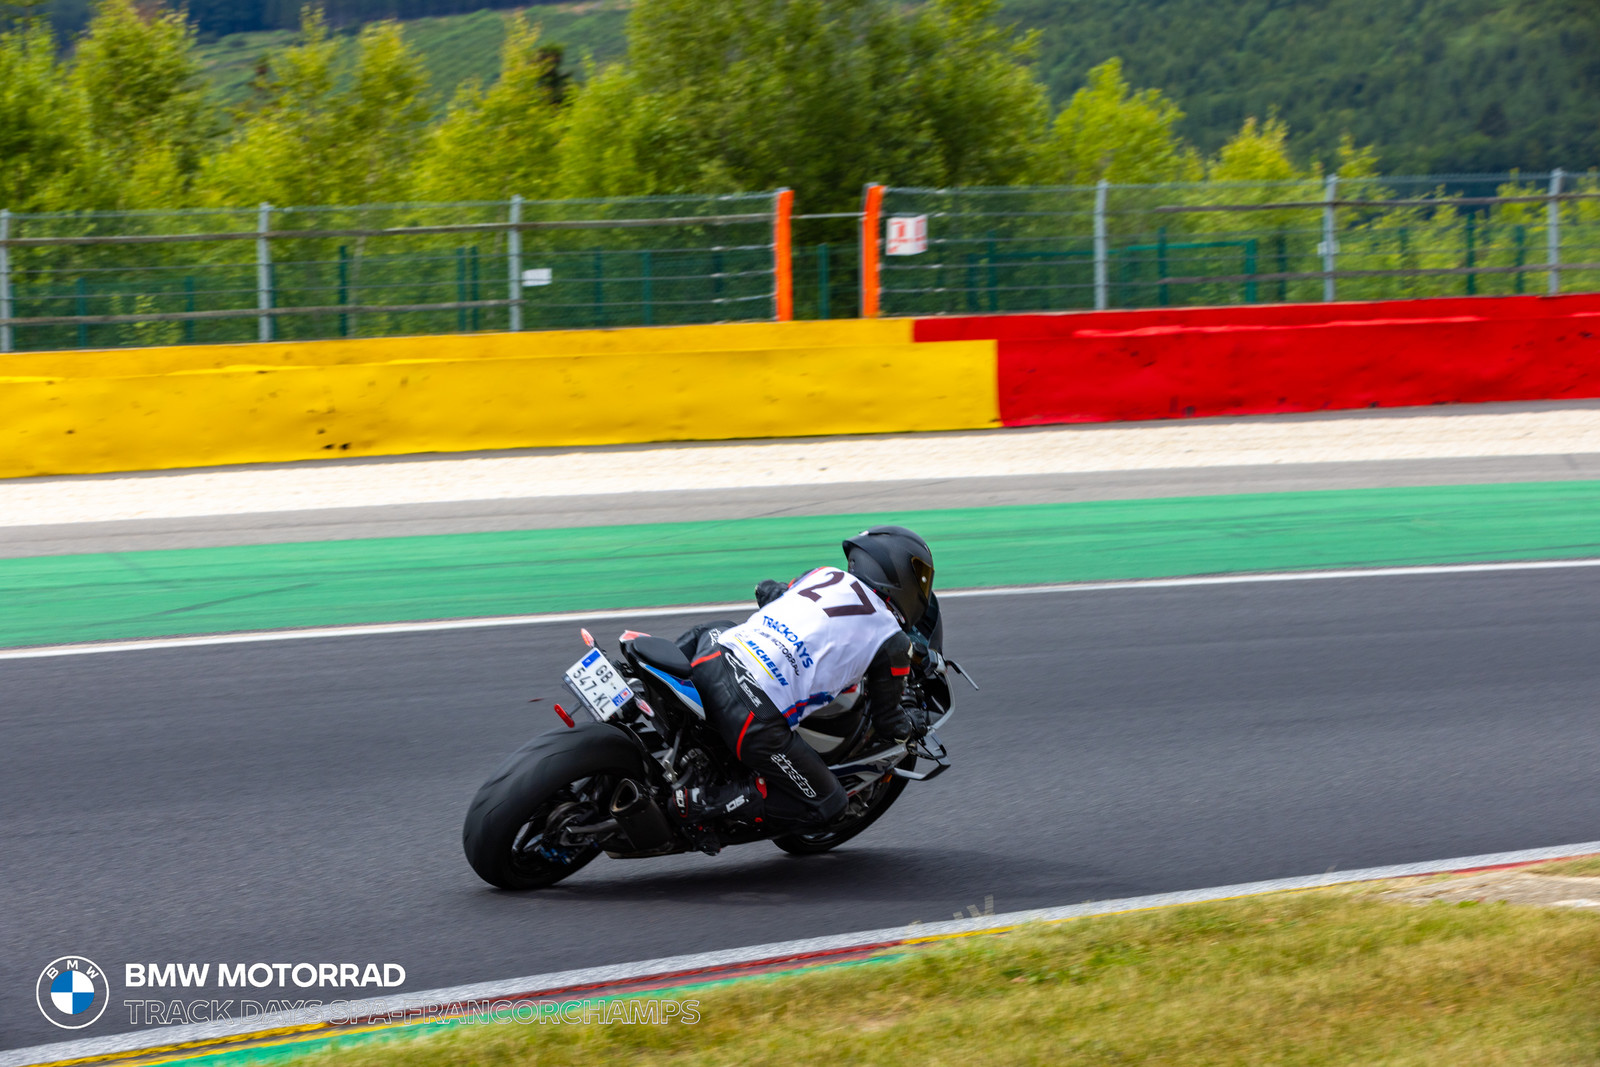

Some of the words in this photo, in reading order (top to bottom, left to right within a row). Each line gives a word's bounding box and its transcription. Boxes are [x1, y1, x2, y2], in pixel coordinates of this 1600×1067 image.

[798, 571, 877, 617] 27
[747, 640, 789, 686] MICHELIN
[762, 615, 814, 669] TRACKDAYS
[572, 667, 609, 714] 547-KL
